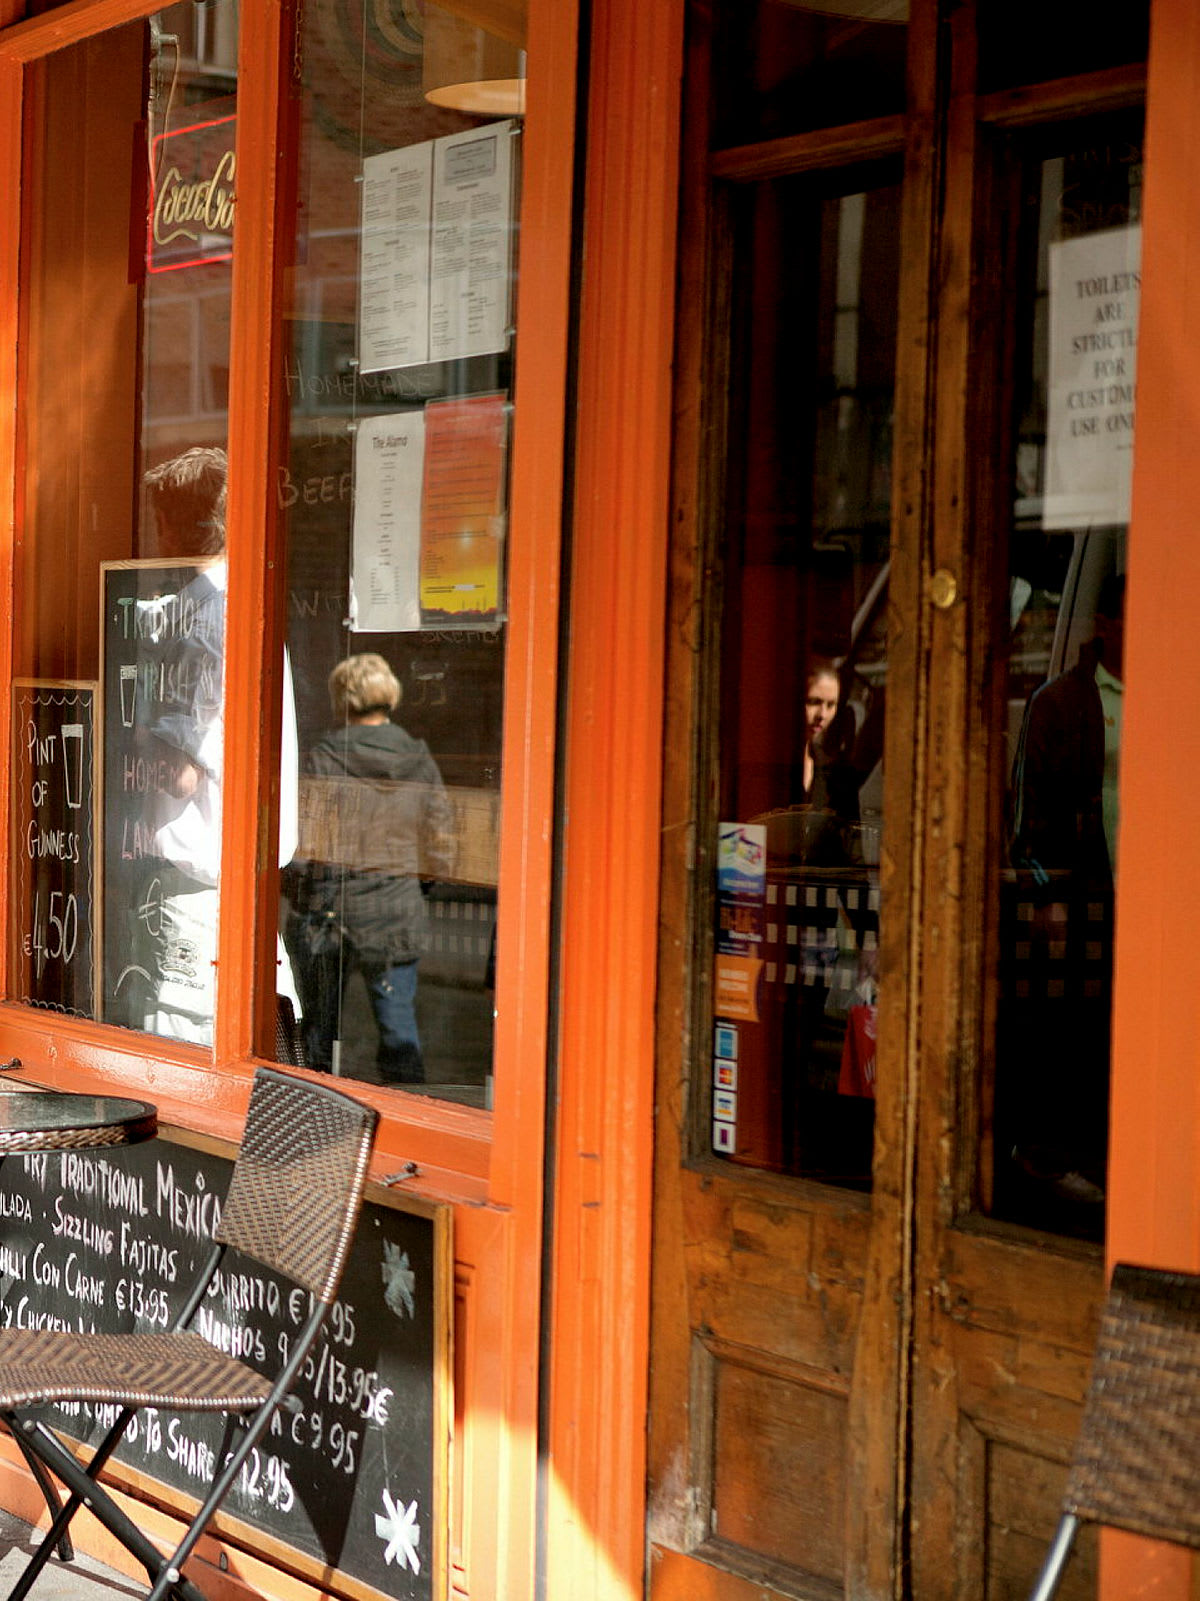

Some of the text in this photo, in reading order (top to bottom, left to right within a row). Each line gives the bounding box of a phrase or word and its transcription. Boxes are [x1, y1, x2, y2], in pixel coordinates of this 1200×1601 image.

[1095, 302, 1124, 324] ARE
[1093, 356, 1127, 380] FOR
[1066, 383, 1137, 410] CUSTOM
[1070, 416, 1099, 438] USE
[27, 719, 57, 765] PINT
[31, 780, 49, 808] OF
[60, 1152, 149, 1218] TRADITIONAL
[51, 1195, 114, 1255] SIZZLING
[120, 1221, 179, 1283] FAJITAS
[32, 1241, 61, 1291] CON
[65, 1252, 105, 1306] CARNE
[115, 1278, 170, 1328] €13.95
[144, 1406, 162, 1454] TO
[166, 1417, 216, 1483] SHARE
